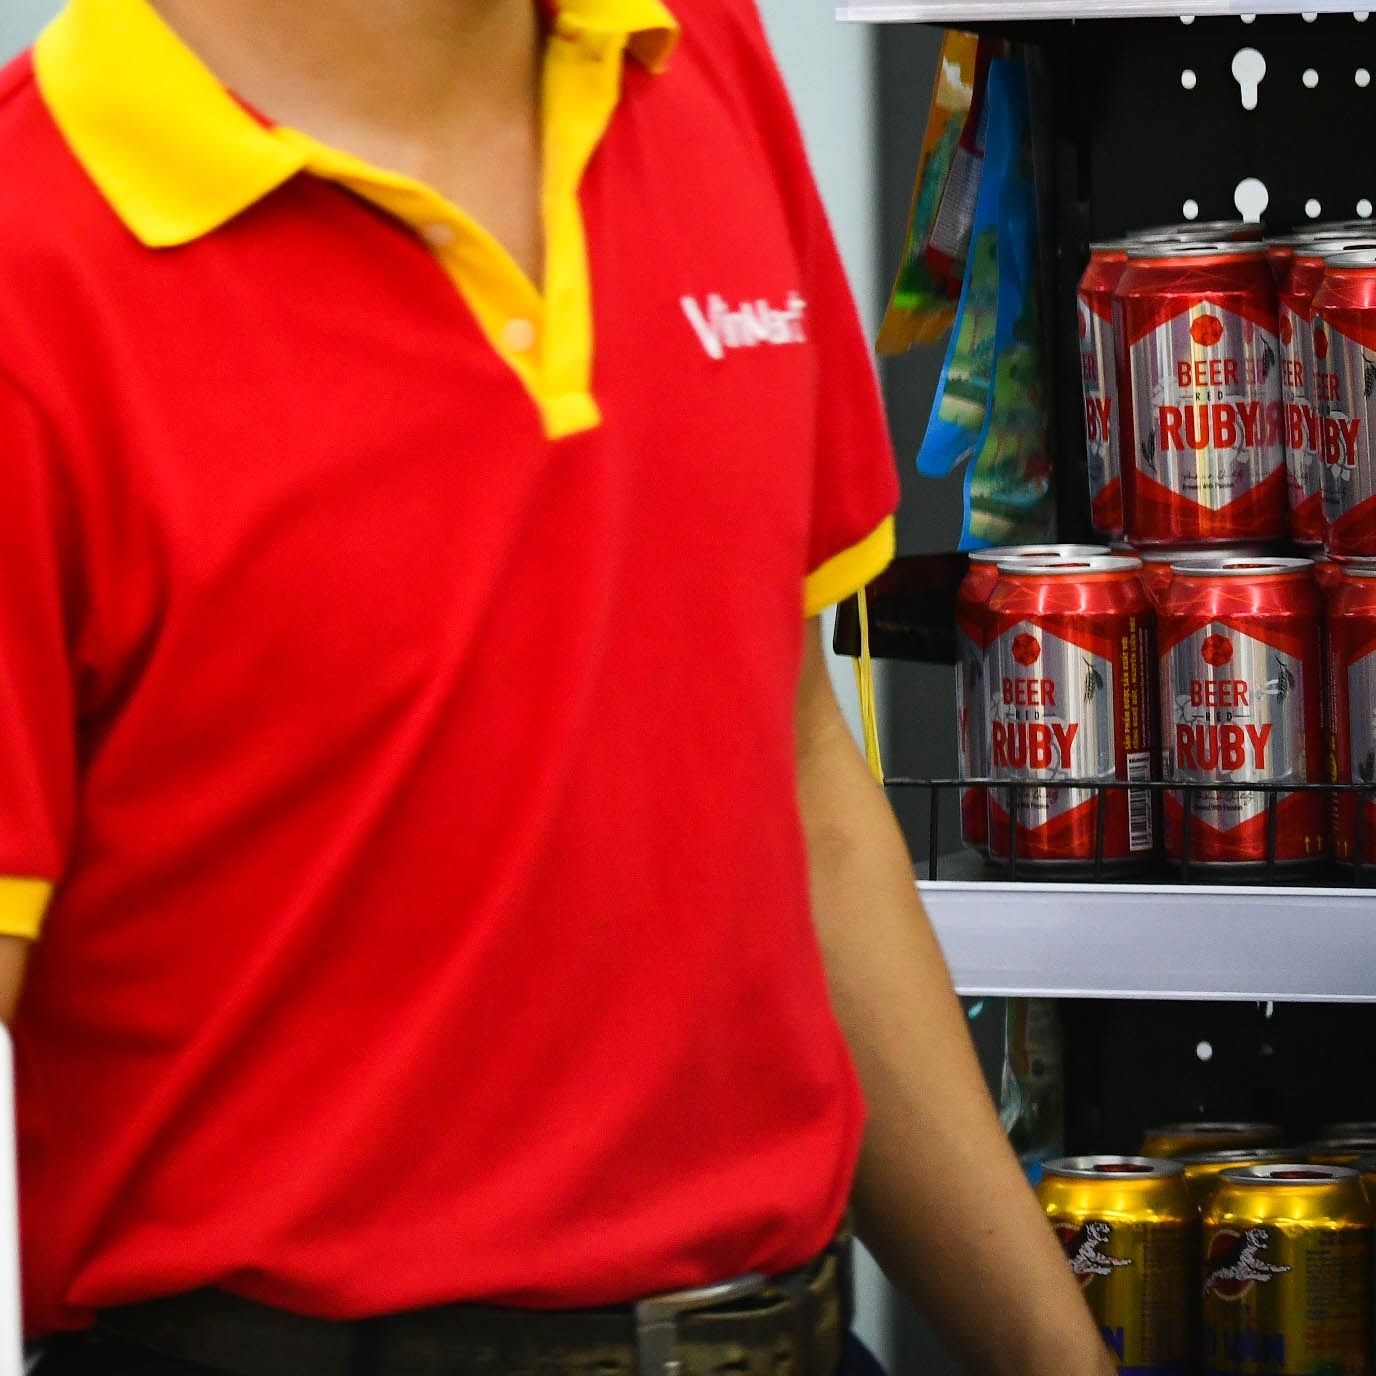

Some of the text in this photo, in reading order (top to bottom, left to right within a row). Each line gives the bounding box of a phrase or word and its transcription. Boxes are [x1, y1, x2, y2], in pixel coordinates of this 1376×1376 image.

[1177, 358, 1239, 387] BEER
[1282, 360, 1304, 387] EER
[1316, 372, 1340, 401] EER
[1086, 396, 1112, 442] BY
[1159, 400, 1260, 451] RUBY
[1284, 401, 1318, 451] BY
[1320, 417, 1361, 465] BY
[1003, 678, 1056, 706] BEER
[1191, 679, 1249, 707] BEER
[1205, 711, 1233, 721] RED
[992, 723, 1078, 769] RUBY
[1176, 723, 1273, 771] RUBY
